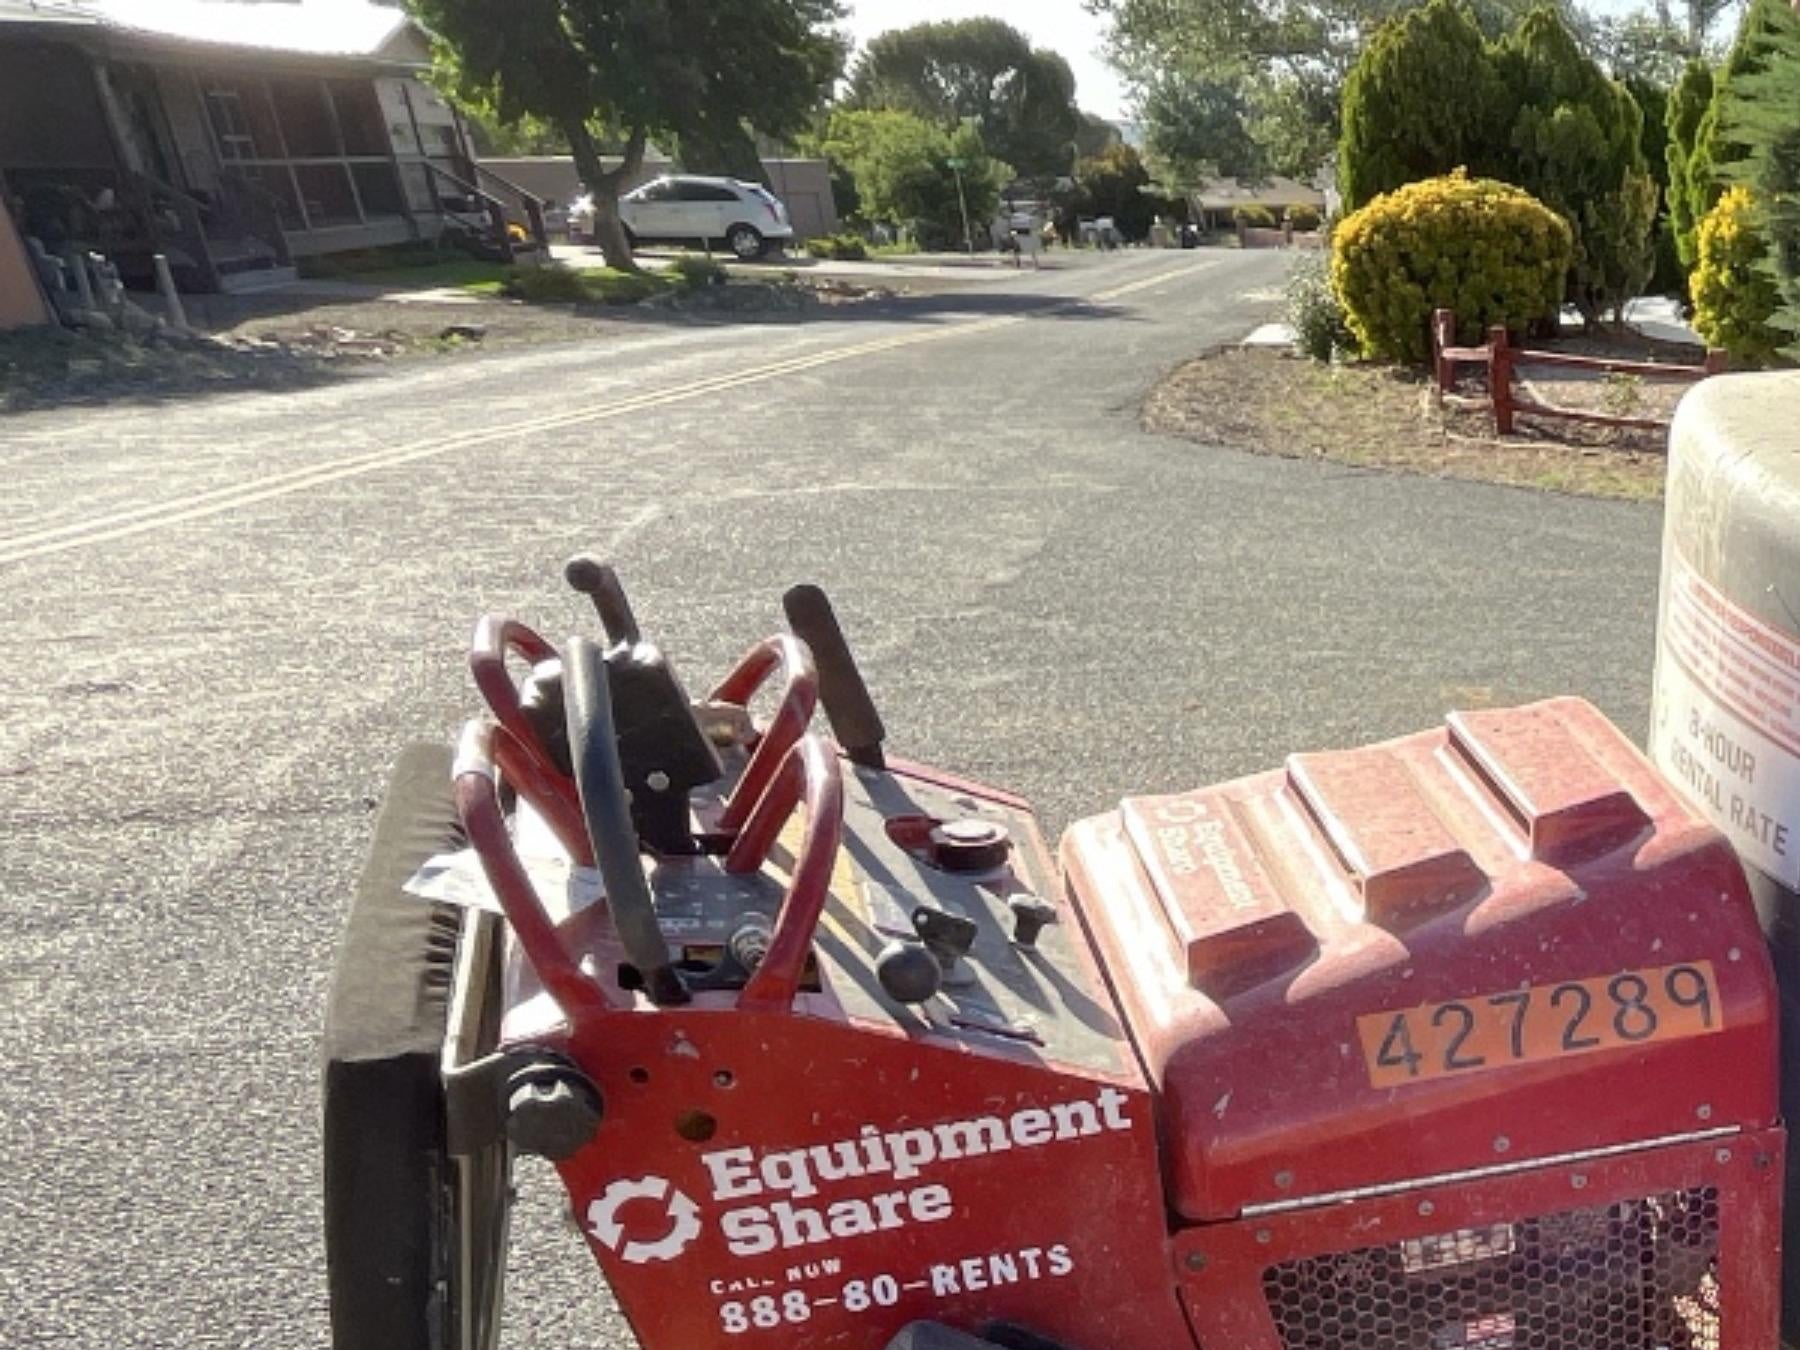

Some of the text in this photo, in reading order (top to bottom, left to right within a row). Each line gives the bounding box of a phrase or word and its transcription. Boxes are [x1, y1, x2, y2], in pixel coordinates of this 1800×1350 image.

[1671, 737, 1789, 857] RENTAL RATE
[1376, 964, 1713, 1076] 427289
[702, 1087, 1132, 1200] Equipment
[720, 1183, 953, 1257] Share
[718, 1244, 1074, 1334] 888-80-RENTS
